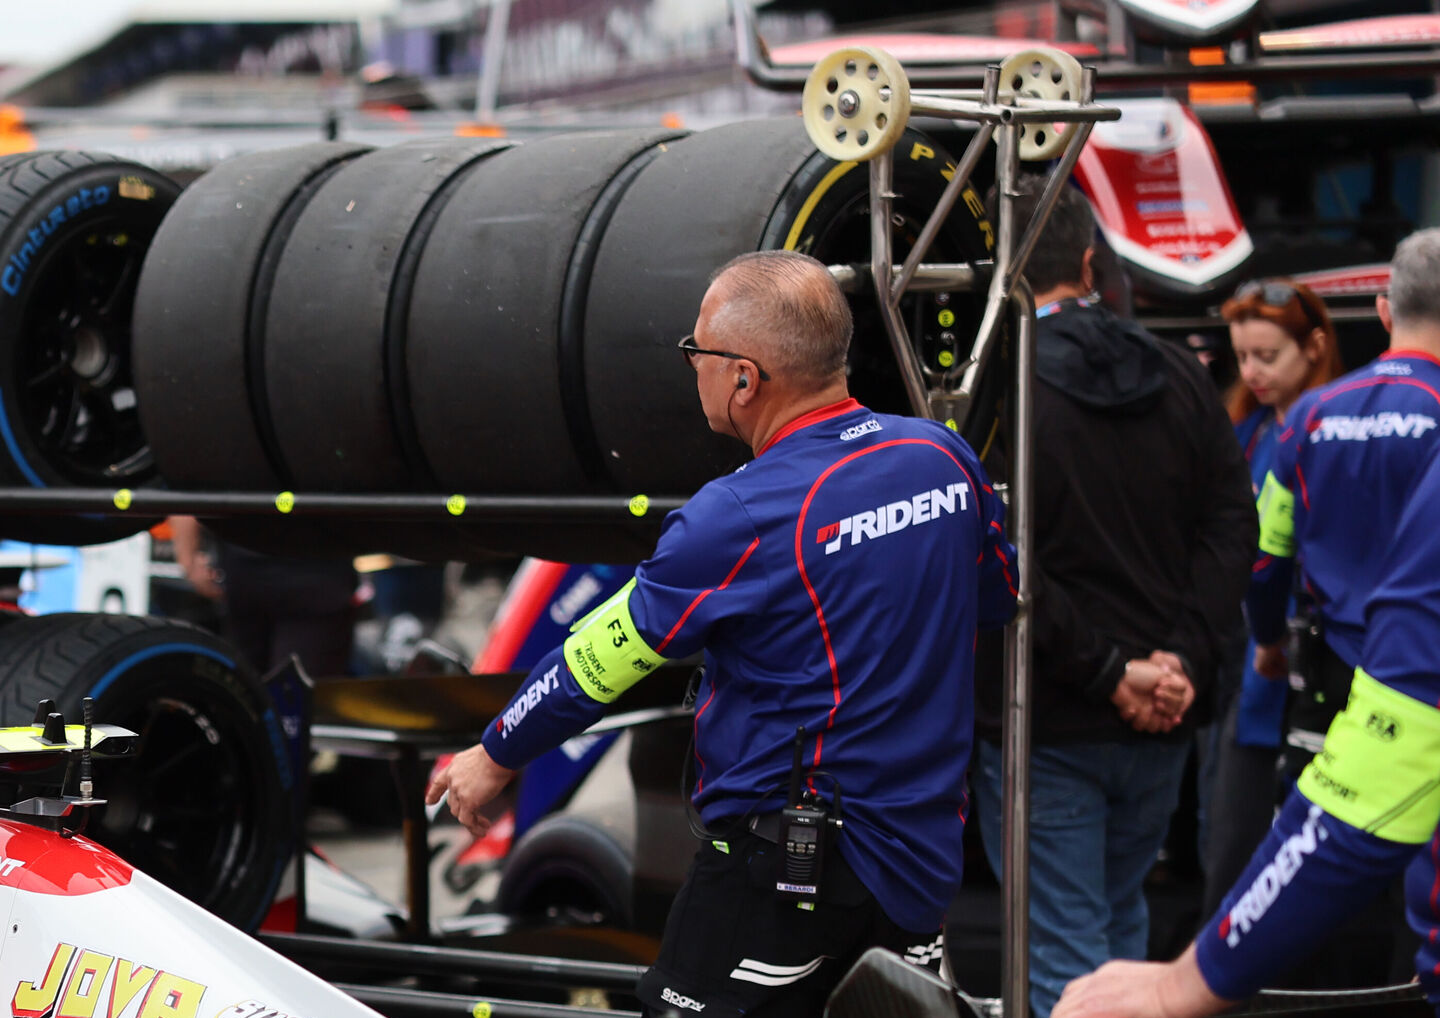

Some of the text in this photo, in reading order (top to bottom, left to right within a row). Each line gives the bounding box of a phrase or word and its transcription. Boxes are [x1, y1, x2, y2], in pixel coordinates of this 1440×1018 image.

[910, 142, 936, 161] P
[839, 417, 884, 443] sparco
[816, 482, 970, 555] TRIDENT
[607, 618, 630, 649] F3
[573, 647, 616, 695] MOTORSPORT
[584, 640, 607, 676] TRIDENT
[496, 664, 562, 741] TRIDENT
